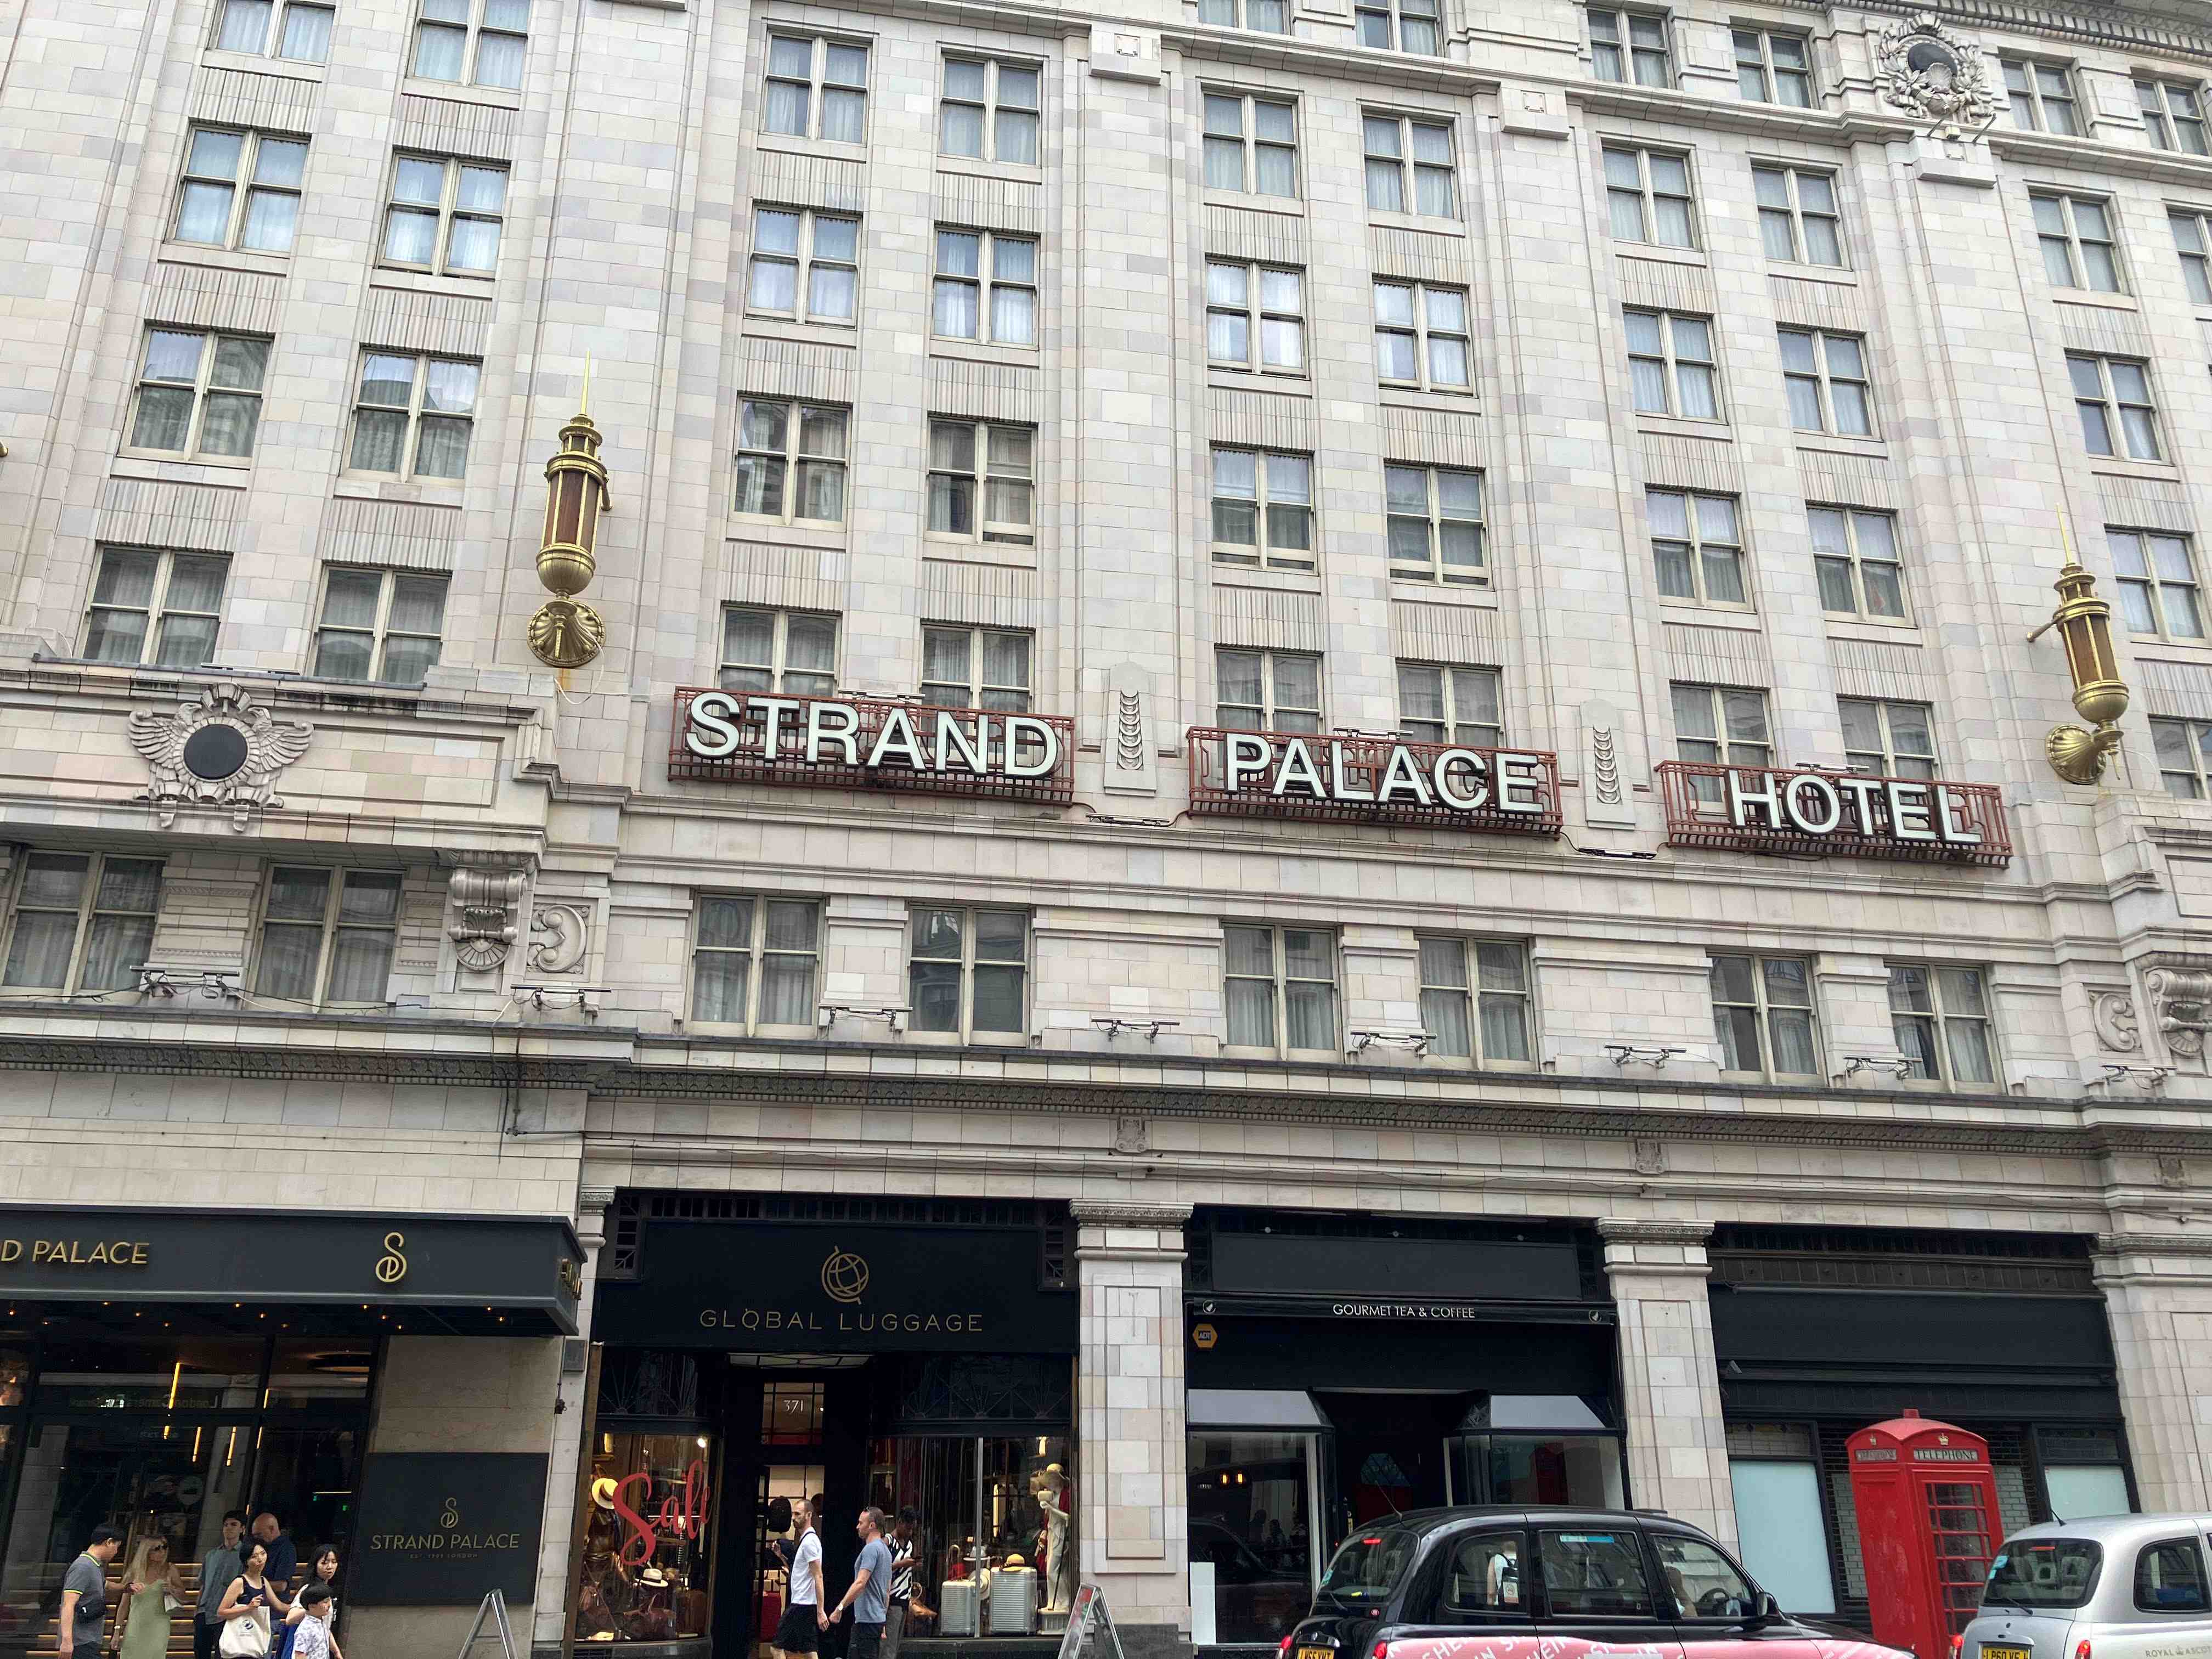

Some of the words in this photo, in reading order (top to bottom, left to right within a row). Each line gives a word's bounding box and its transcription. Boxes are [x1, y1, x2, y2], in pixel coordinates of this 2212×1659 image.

[685, 691, 1059, 777] STRAND
[1224, 733, 1544, 814] PALACE
[1724, 769, 1982, 843] HOTEL
[31, 1240, 150, 1264] PALACE
[1333, 1304, 1391, 1317] GOURMET
[1394, 1306, 1415, 1317] TEA
[1419, 1307, 1427, 1317] &
[1430, 1307, 1476, 1318] COFFEE
[699, 1308, 823, 1331] GLOBAL
[839, 1313, 983, 1332] LUGGAGE
[1198, 1331, 1211, 1339] ADT
[783, 1400, 804, 1414] 371
[1917, 1449, 1978, 1461] TELEPHONE
[612, 1459, 713, 1566] Sale
[370, 1534, 444, 1550] STRAND
[450, 1533, 520, 1549] PALACE
[2145, 1648, 2174, 1657] ROYAL
